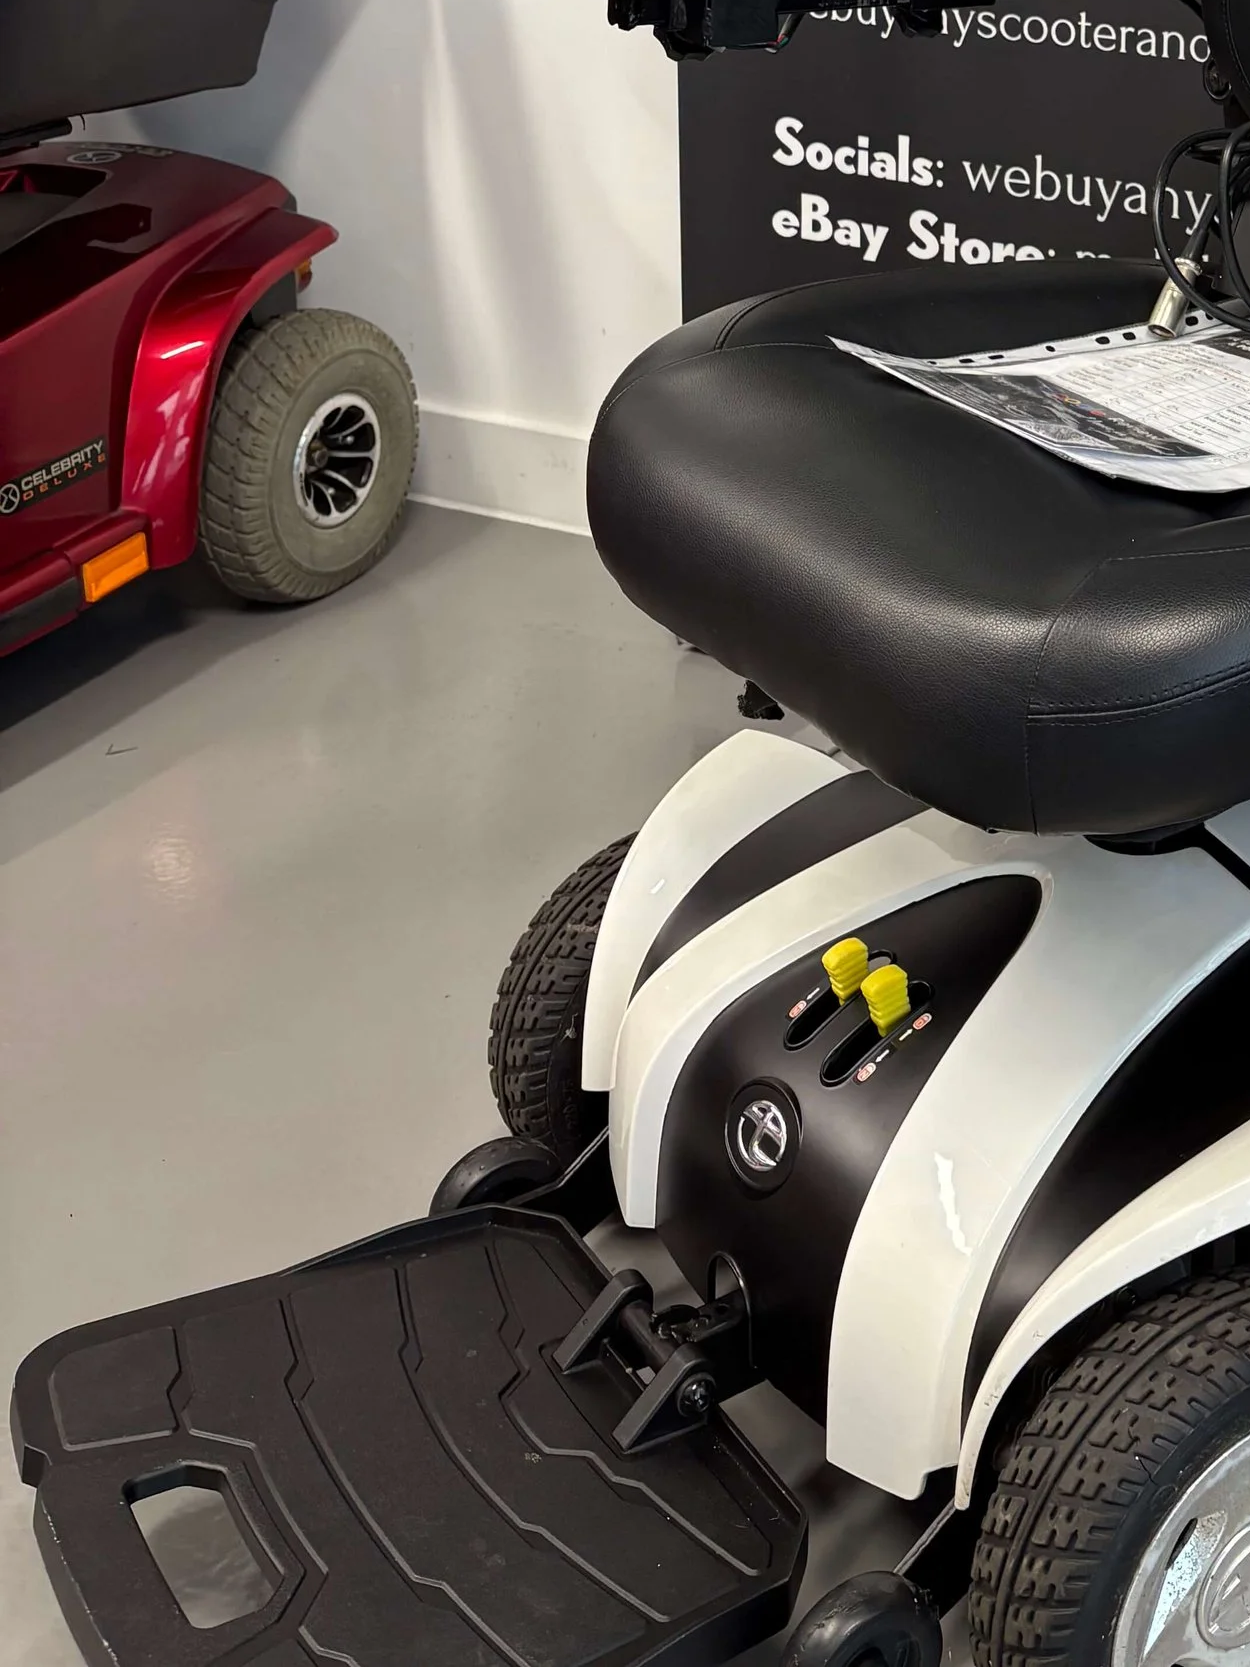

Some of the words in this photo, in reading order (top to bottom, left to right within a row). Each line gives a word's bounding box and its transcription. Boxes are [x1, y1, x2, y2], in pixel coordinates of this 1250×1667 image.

[772, 116, 944, 188] Socials:
[961, 154, 1219, 236] webuyany
[771, 192, 889, 262] eBay
[20, 439, 103, 491] CELEBRITY
[22, 452, 106, 502] DELUXE
